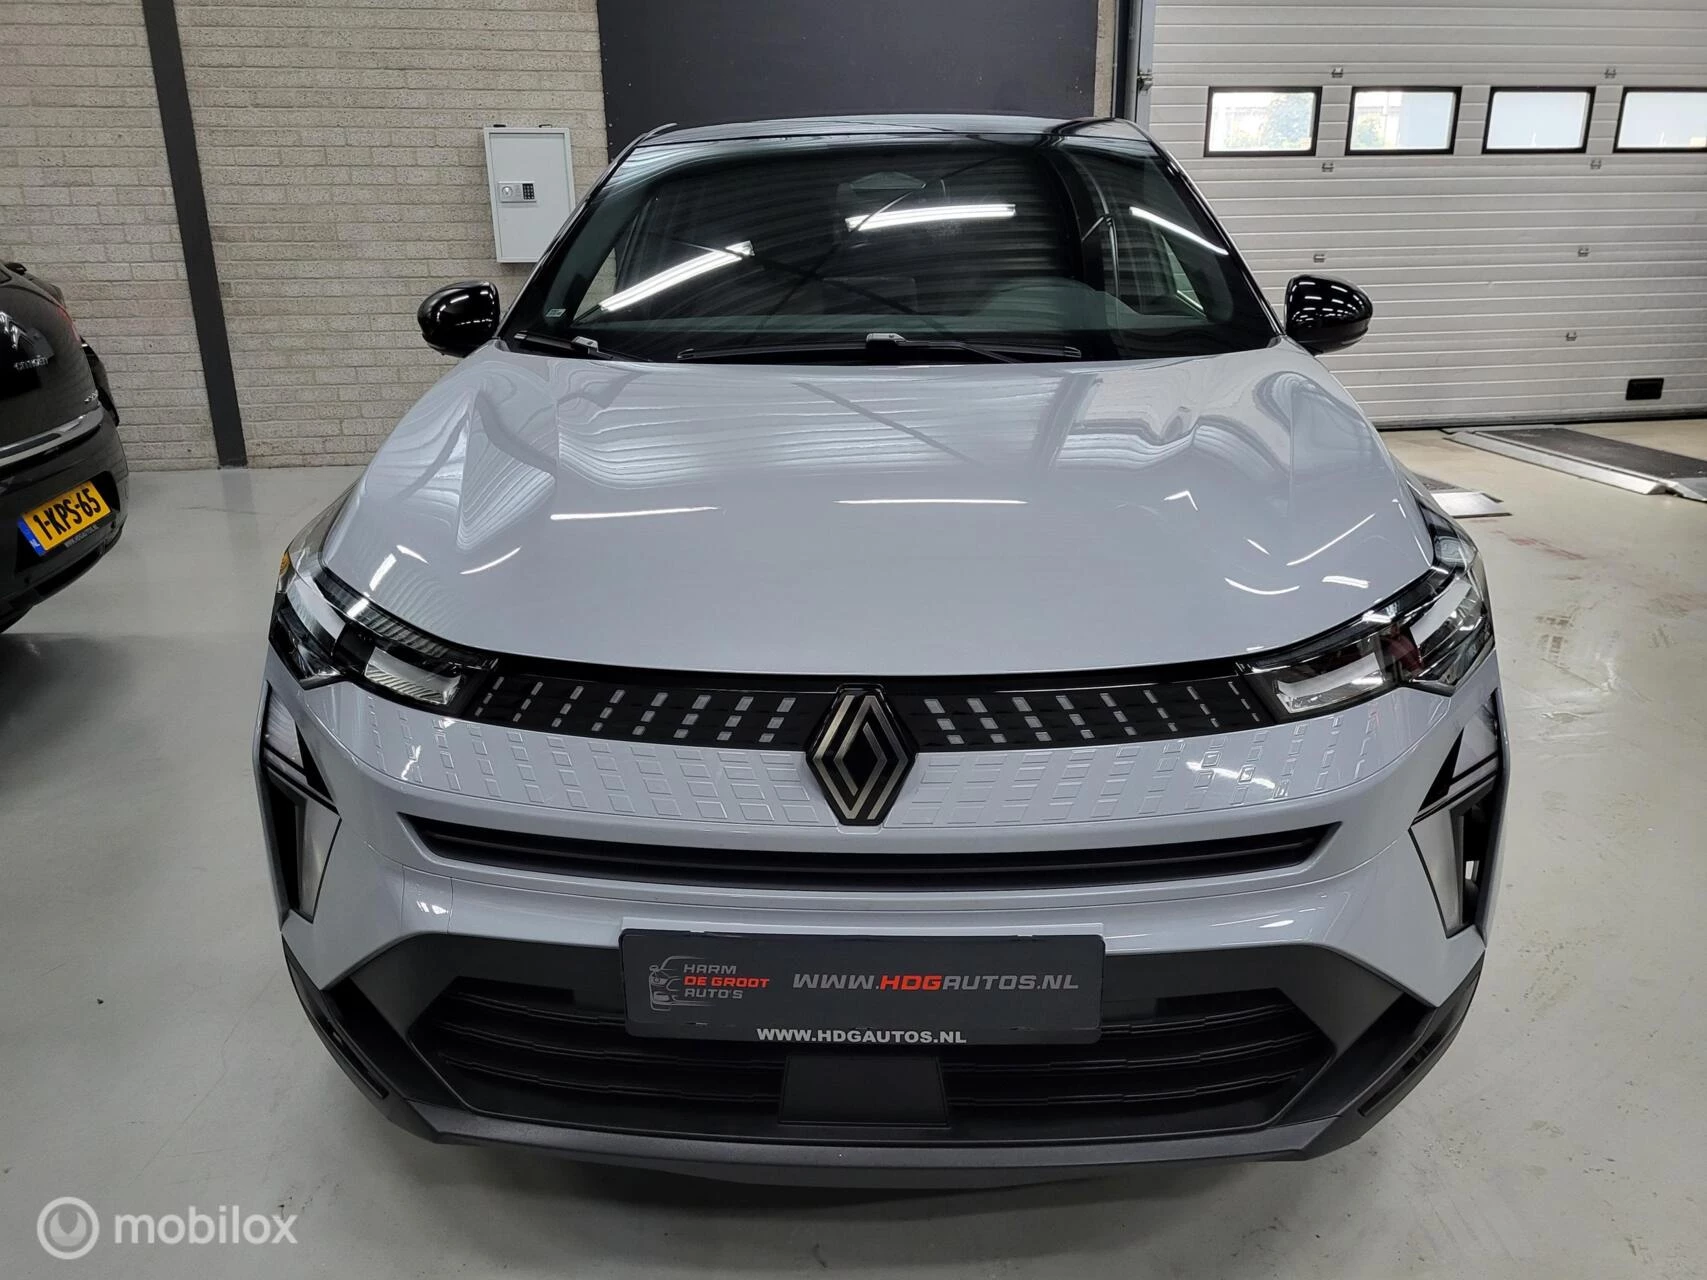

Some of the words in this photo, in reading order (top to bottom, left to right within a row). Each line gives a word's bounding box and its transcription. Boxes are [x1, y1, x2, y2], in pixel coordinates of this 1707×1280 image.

[33, 487, 102, 541] 1-KPS-65
[683, 963, 737, 975] HARM
[684, 975, 708, 986] DE
[711, 976, 770, 988] GROOT
[792, 973, 1080, 991] WWW.HDGAUTOS.NL
[684, 988, 744, 1000] AUTO'S
[756, 1027, 967, 1044] WWW.HDGAUTOS.NL
